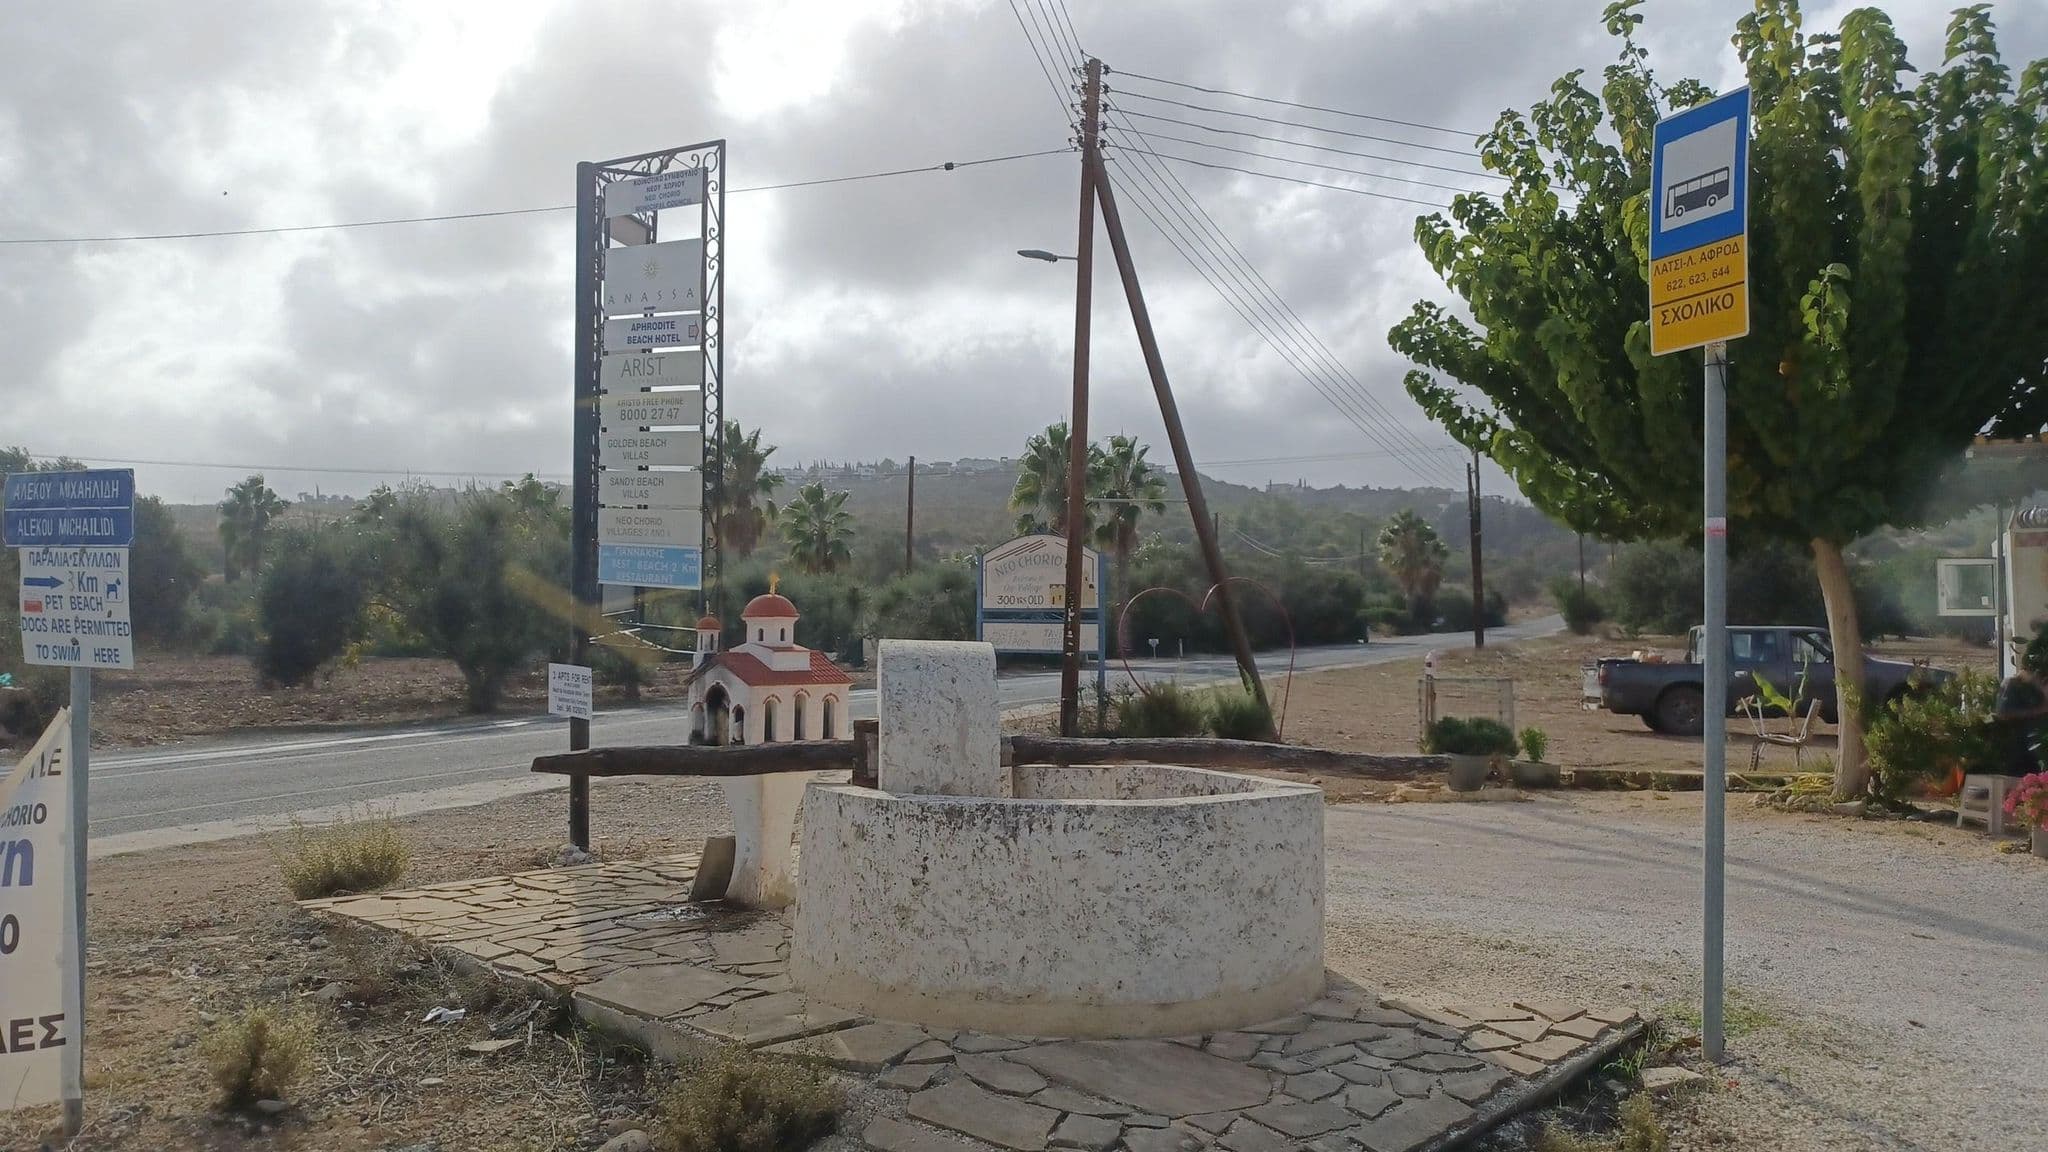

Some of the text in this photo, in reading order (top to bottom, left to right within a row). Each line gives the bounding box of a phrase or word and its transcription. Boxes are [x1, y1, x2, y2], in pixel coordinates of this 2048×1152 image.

[1699, 241, 1740, 263] ΑΦΡΟΔ
[1666, 265, 1730, 292] 622, 623, 644
[608, 287, 695, 306] ANASSA
[1661, 292, 1735, 326] ΣΧΟΛΙΚΟ
[631, 320, 676, 331] APHRODITE
[627, 333, 681, 345] BEACH HOTEL
[642, 398, 659, 406] FREE
[660, 396, 684, 406] PHONE
[620, 408, 647, 420] 8000
[608, 438, 667, 448] GOLDEN BEACH
[622, 451, 649, 460] VILLAS
[14, 479, 120, 501] ΑΛΕΚΟΥ ΜΙΧΑΗΛΙΔΗ
[609, 477, 665, 487] SANDY BEACH
[622, 489, 649, 499] VILLAS
[17, 517, 115, 537] ALEKOU MICHAILIDI
[616, 516, 663, 525] NEO CHORIO
[606, 527, 643, 537] VILLAGES
[29, 551, 70, 568] ΠΑΡΑΛΙΑ
[636, 560, 669, 571] BEACH
[1018, 553, 1063, 569] CHORIO
[78, 571, 98, 593] Km
[44, 595, 103, 612] PET BEACH
[997, 595, 1016, 605] 300
[1028, 594, 1045, 605] OLD
[22, 616, 130, 637] DOGS ARE PERMITTED
[35, 644, 120, 664] TO SWIM HERE
[0, 802, 47, 829] HORIO
